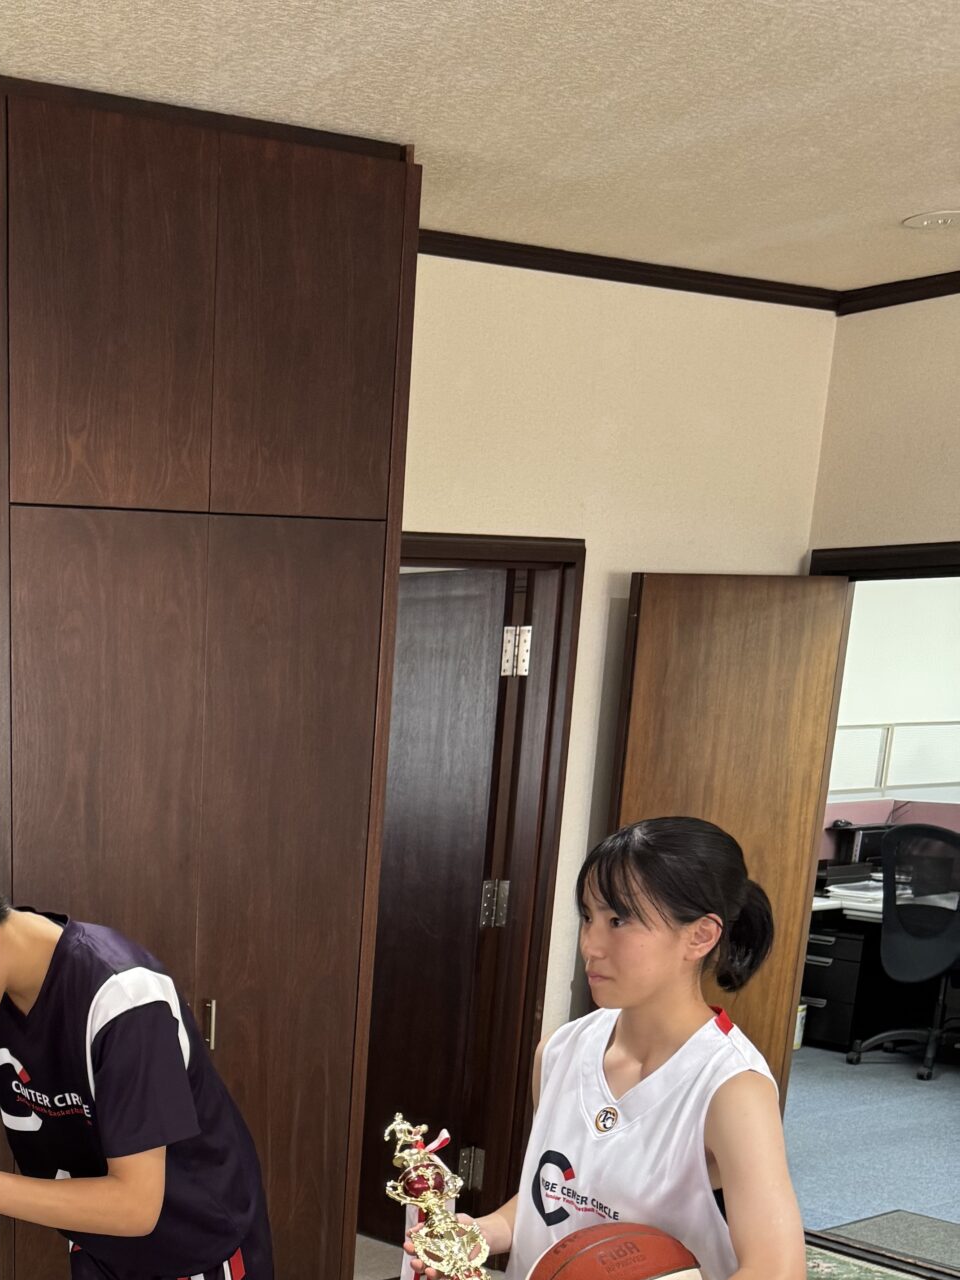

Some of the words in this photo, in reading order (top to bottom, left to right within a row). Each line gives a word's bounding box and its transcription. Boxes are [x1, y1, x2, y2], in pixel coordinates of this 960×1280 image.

[54, 1093, 91, 1117] CIRE
[561, 1187, 588, 1205] CENER
[591, 1198, 619, 1220] CIRCLE
[598, 1242, 639, 1265] FIBA
